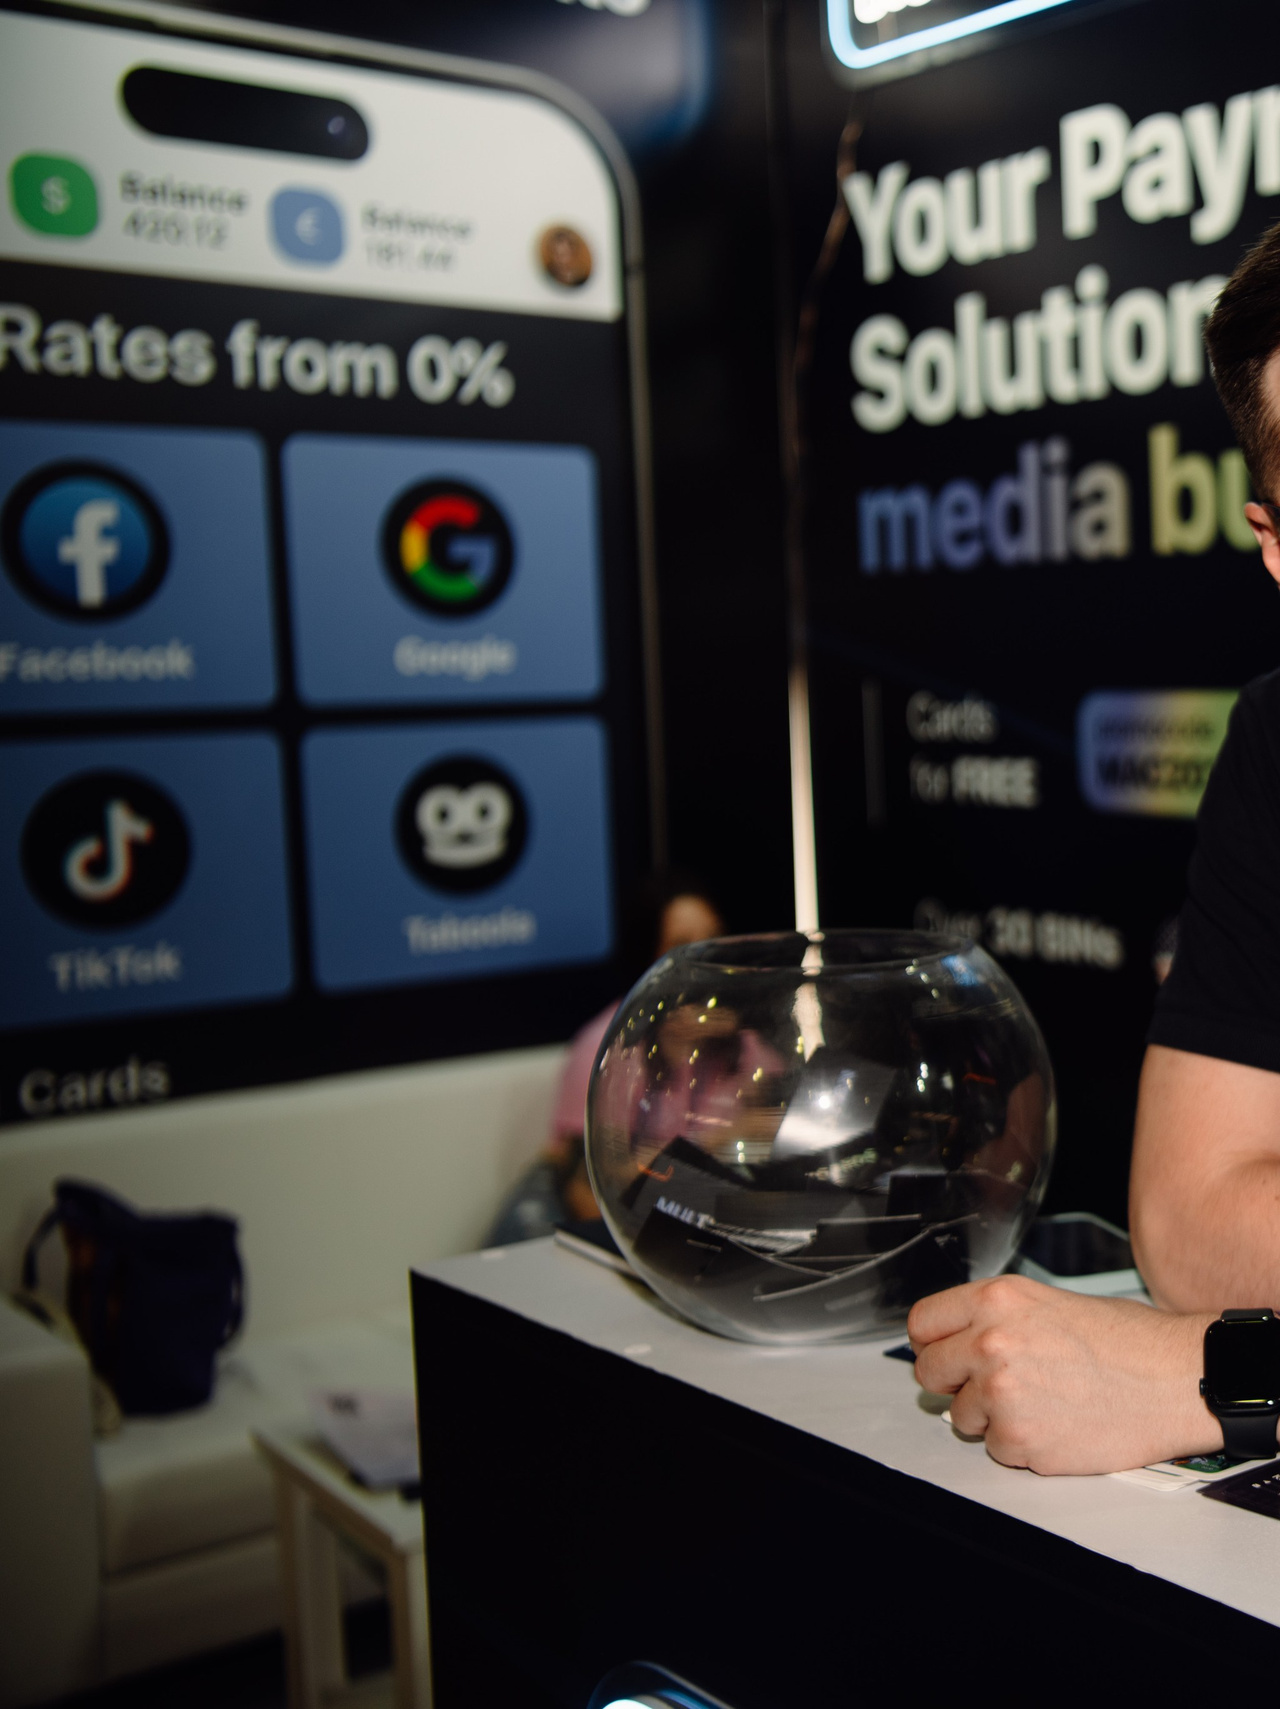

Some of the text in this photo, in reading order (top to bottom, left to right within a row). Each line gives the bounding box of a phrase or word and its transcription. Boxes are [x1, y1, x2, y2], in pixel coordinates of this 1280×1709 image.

[120, 170, 248, 215] Balance
[842, 146, 1050, 285] Your
[0, 303, 515, 409] Rates from 0%
[857, 437, 1131, 575] media
[0, 639, 195, 684] Facebook
[393, 635, 517, 681] Google
[50, 941, 182, 992] TikTok
[20, 1056, 172, 1116] Cards
